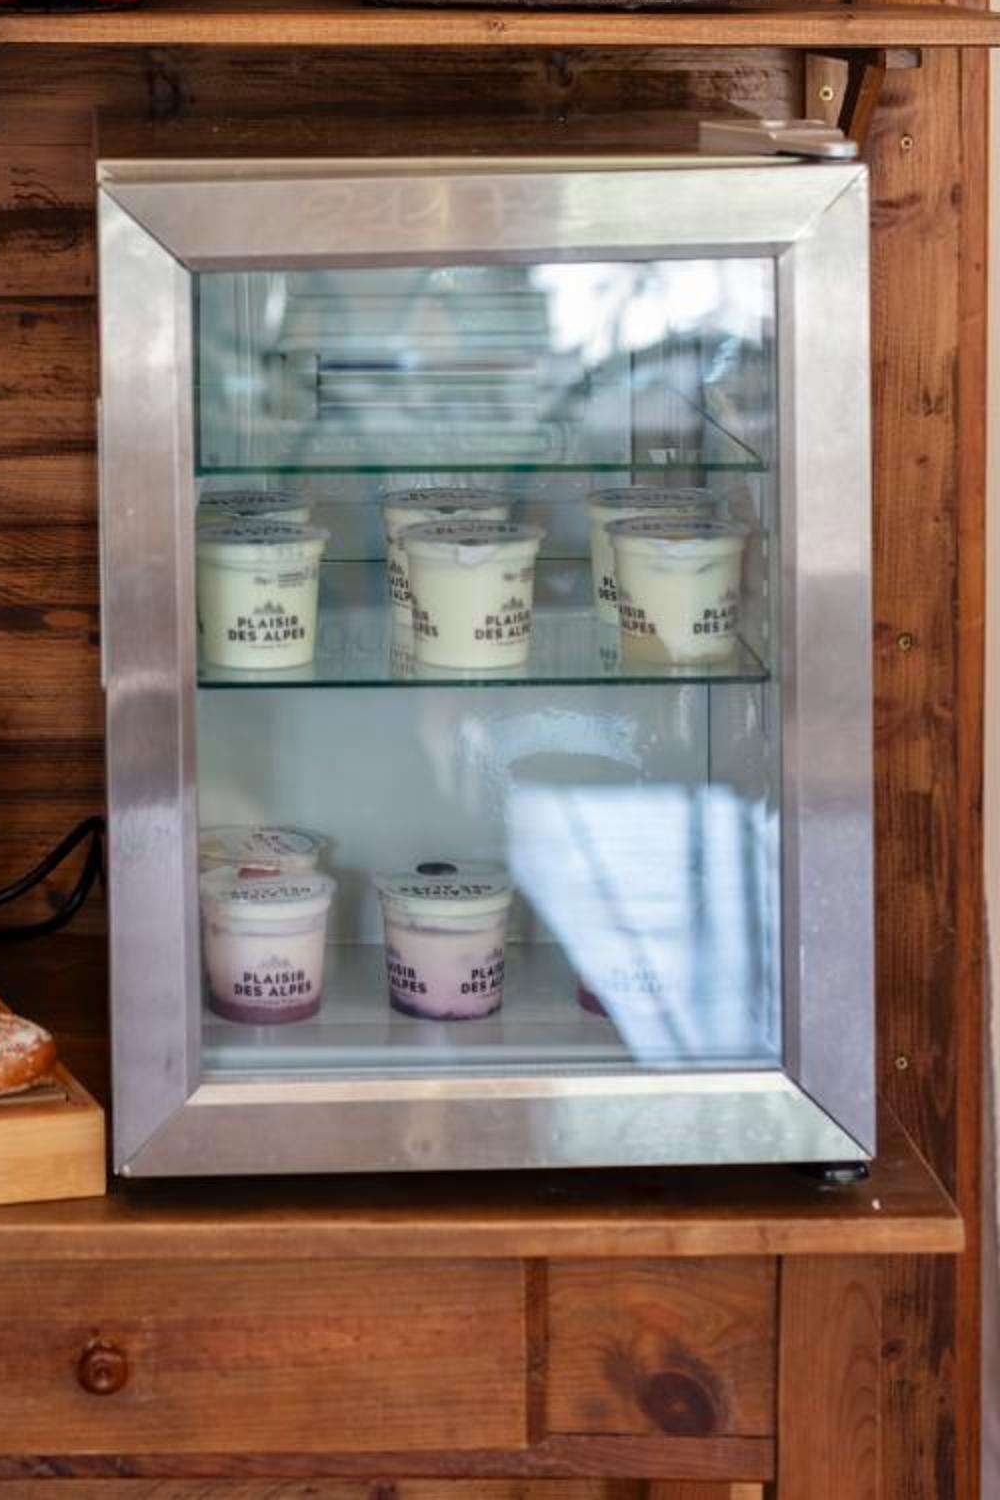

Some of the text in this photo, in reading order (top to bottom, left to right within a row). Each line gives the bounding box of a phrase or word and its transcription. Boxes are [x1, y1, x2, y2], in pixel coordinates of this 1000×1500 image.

[237, 614, 299, 630] PLAISIR
[692, 621, 720, 635] DES
[227, 627, 305, 642] DES ALPES
[474, 627, 503, 640] DES
[243, 969, 305, 985] PLAISIR
[233, 980, 312, 997] DES ALPES
[461, 980, 487, 994] DES
